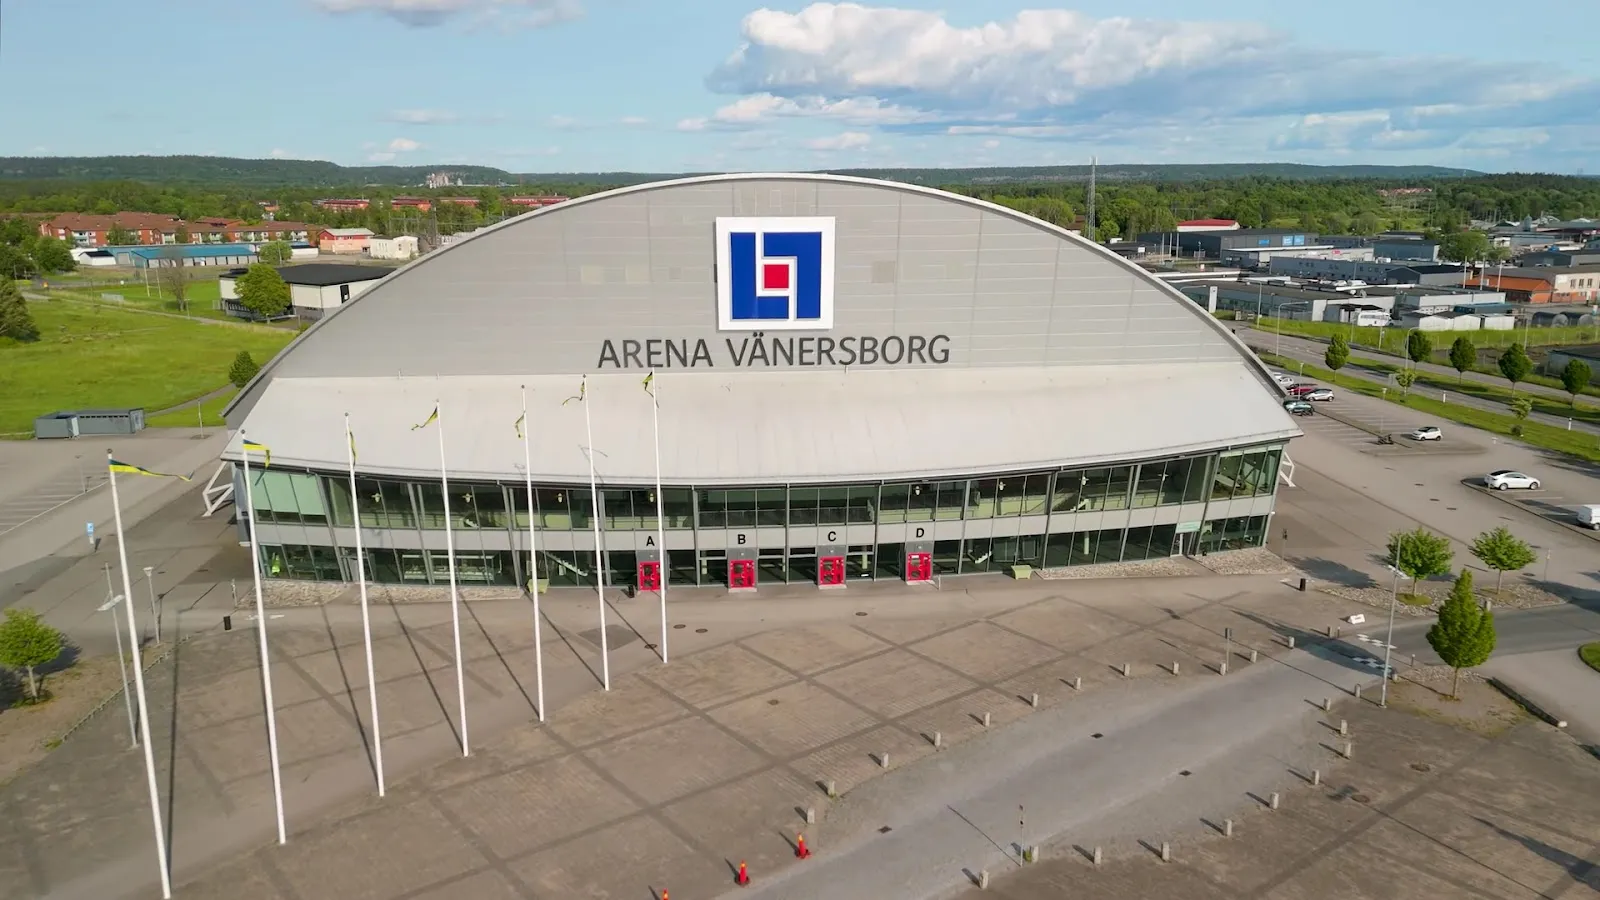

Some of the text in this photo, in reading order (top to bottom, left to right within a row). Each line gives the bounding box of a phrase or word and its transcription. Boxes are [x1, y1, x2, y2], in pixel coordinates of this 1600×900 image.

[597, 331, 951, 369] ARENA VÄNERSBORG
[827, 531, 836, 541] C
[915, 527, 925, 538] D
[646, 535, 655, 546] A
[737, 533, 746, 544] B
